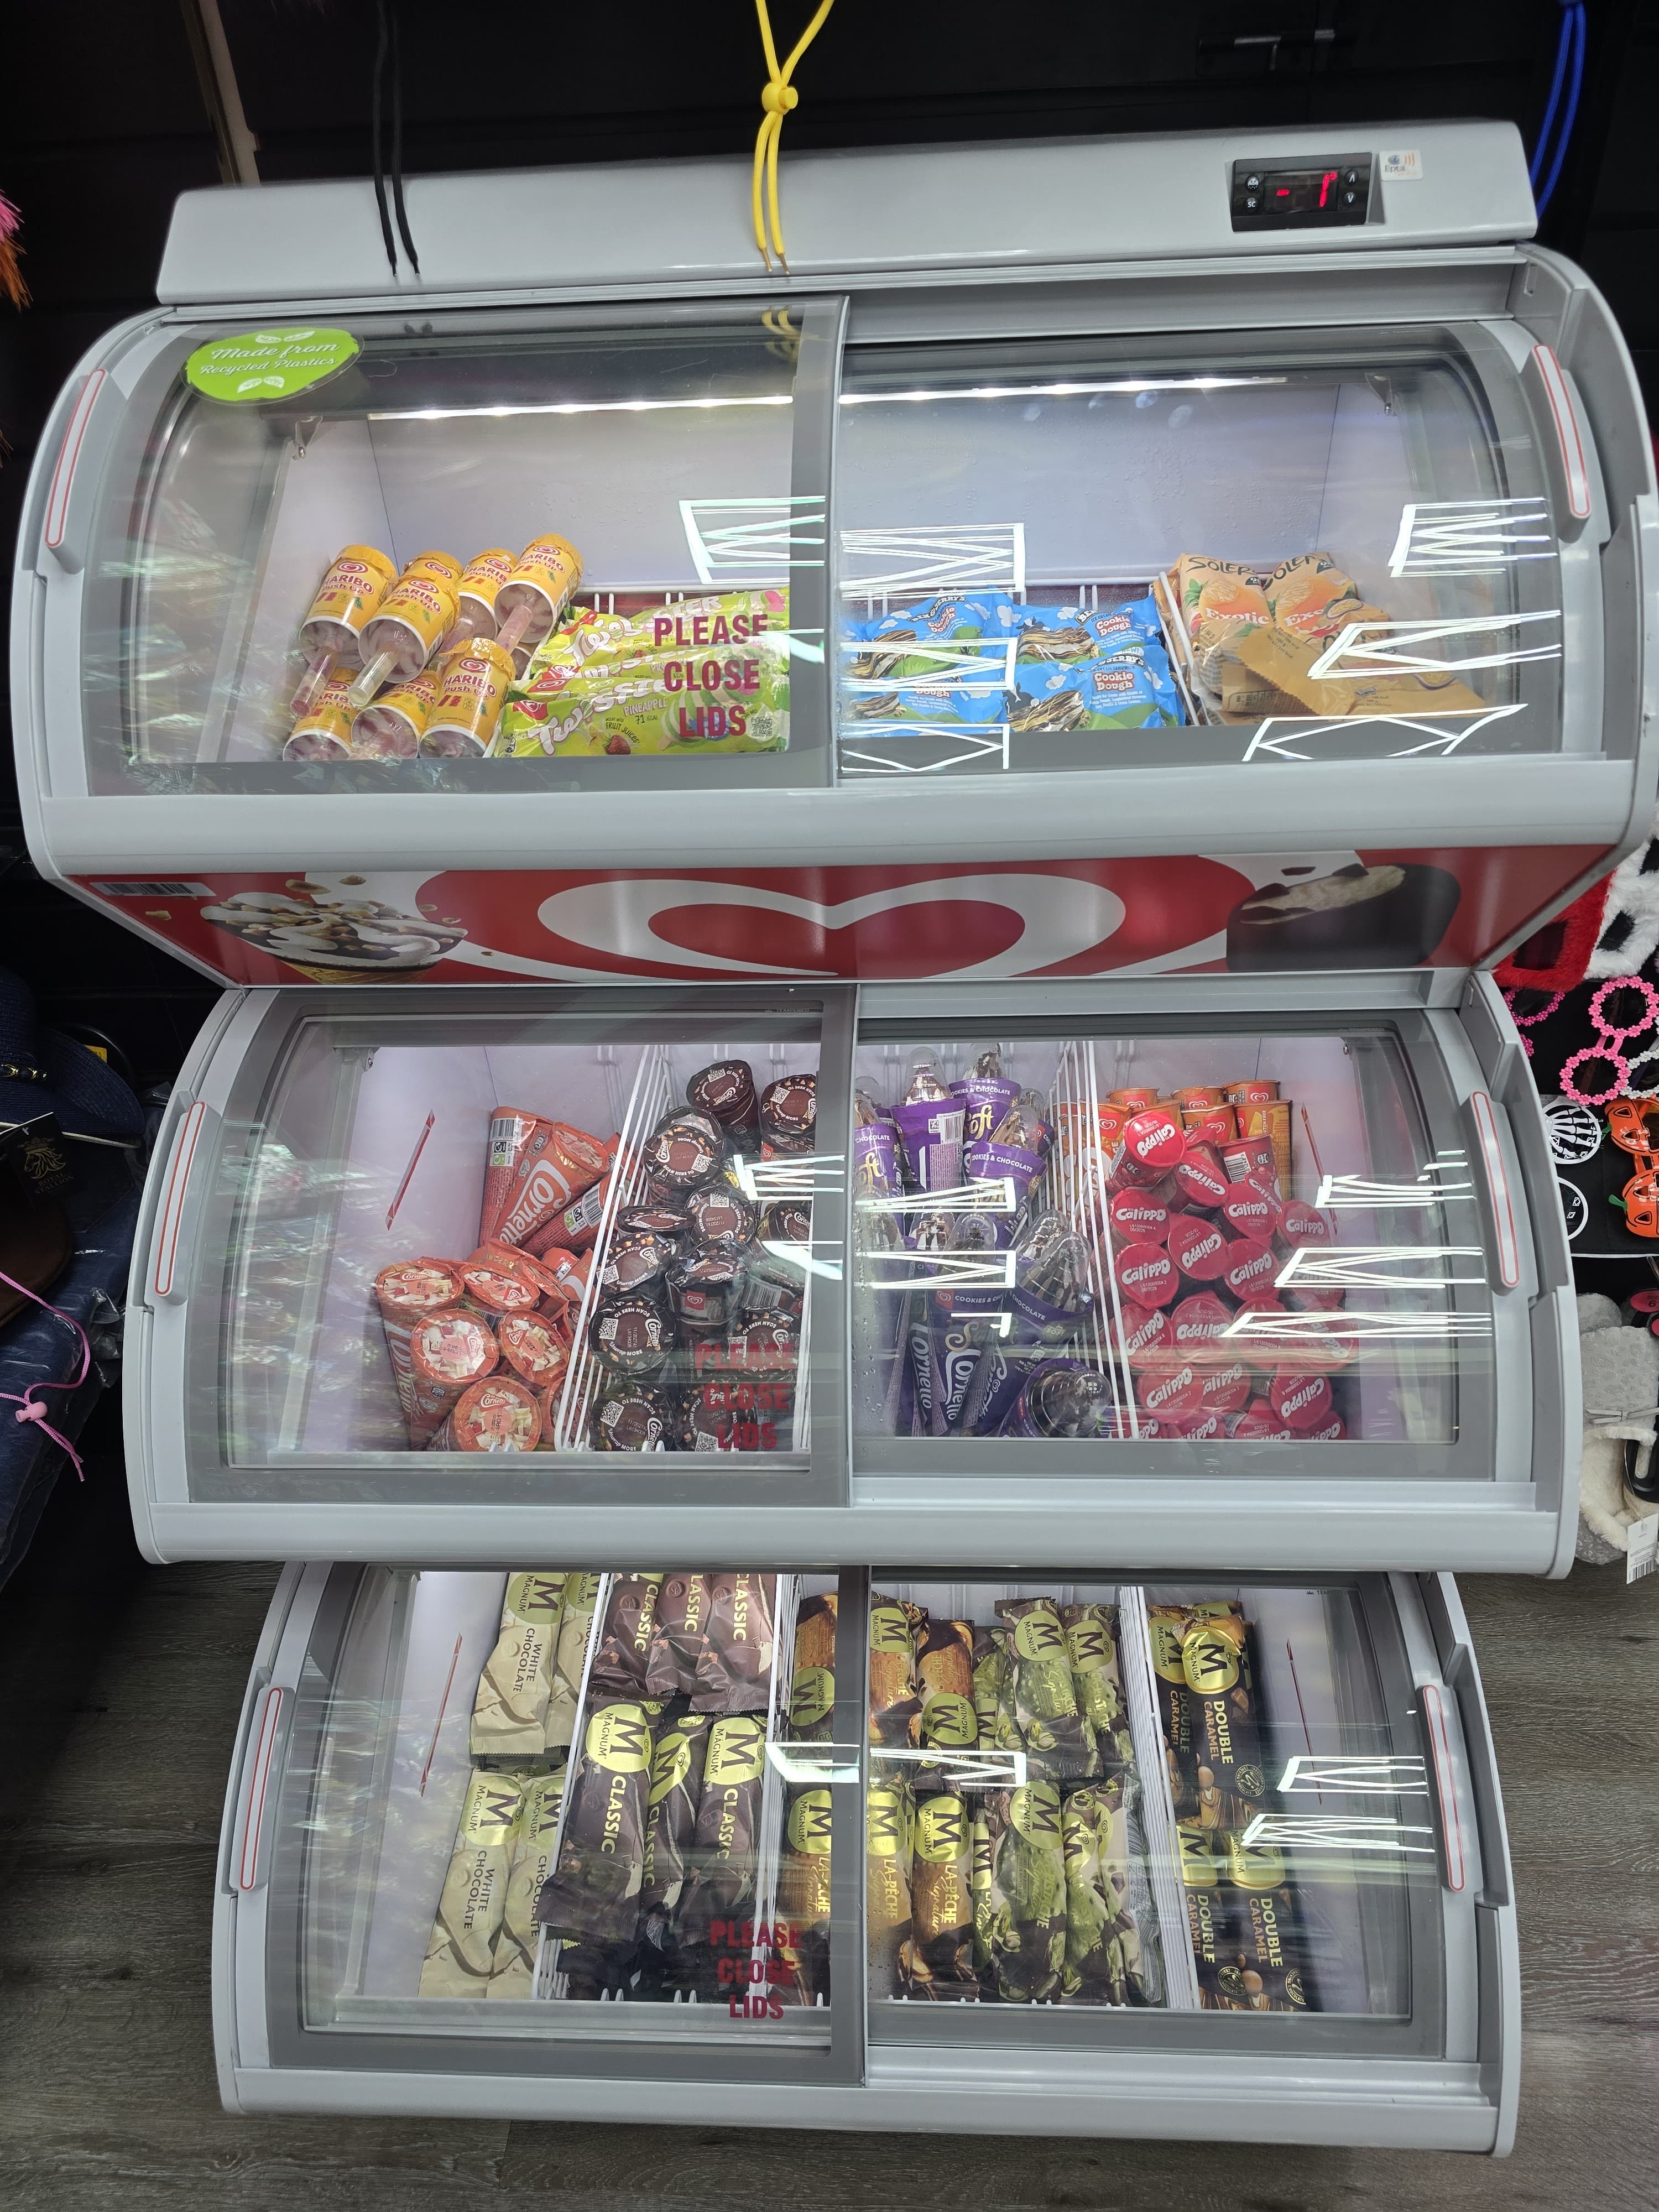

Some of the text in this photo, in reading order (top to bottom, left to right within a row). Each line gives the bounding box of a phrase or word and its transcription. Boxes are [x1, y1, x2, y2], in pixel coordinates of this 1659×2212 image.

[1385, 165, 1405, 173] Epta
[200, 357, 337, 375] Recycled Plastics
[212, 343, 340, 359] Made from
[470, 566, 508, 582] HARIB
[1186, 557, 1257, 576] SOLER
[325, 575, 374, 594] HARIBO
[393, 588, 442, 614] HARIBO
[655, 614, 768, 646] PLEASE
[1099, 623, 1131, 637] Dough
[1204, 607, 1271, 625] Exotic
[1283, 608, 1324, 627] Exo
[444, 674, 497, 696] HARIBO
[664, 659, 760, 692] CLOSE
[1094, 671, 1134, 681] Cookie
[1097, 681, 1134, 691] Dough
[624, 698, 667, 717] PINEAPPLE
[636, 715, 645, 724] 71
[679, 705, 747, 738] LIDS
[606, 722, 620, 731] FRUIT
[975, 1086, 1010, 1095] CHOCOLATE
[969, 1104, 995, 1140] oft
[1137, 1124, 1176, 1157] Calippo
[996, 1156, 1034, 1173] CHOCOLATE
[1178, 1164, 1225, 1196] Calippo
[1228, 1201, 1269, 1217] Calippo
[1249, 1178, 1282, 1213] Calippo
[1116, 1207, 1167, 1222] Calippo
[1286, 1218, 1325, 1235] Calippo
[1182, 1233, 1222, 1268] Calippo
[1121, 1259, 1171, 1285] Calippo
[1230, 1253, 1272, 1285] Calippo
[635, 1307, 650, 1318] SCAN
[1012, 1293, 1047, 1321] CHOCOLATE
[609, 1340, 627, 1357] Unwrap
[645, 1318, 662, 1347] Cornetto
[1125, 1311, 1165, 1357] Calippo
[695, 1343, 797, 1371] PLEASE
[1146, 1368, 1193, 1408] Calippo
[1203, 1363, 1243, 1396] alippo
[480, 1393, 506, 1407] Cornetto
[643, 1401, 656, 1415] SCAN
[703, 1383, 790, 1410] CLOSE
[1281, 1378, 1324, 1418] Calippo
[608, 1428, 621, 1447] Unwrap
[717, 1422, 778, 1449] LIDS
[518, 1575, 535, 1613] MAGNUM
[528, 1579, 566, 1612] M
[684, 1574, 704, 1632] LASSIC
[634, 1584, 659, 1651] CLASSIC
[872, 1614, 881, 1647] MAGNUM
[880, 1617, 907, 1644] M
[1023, 1621, 1038, 1657] MAGNUM
[1032, 1622, 1063, 1651] M
[1068, 1631, 1079, 1668] MAGNUM
[1077, 1631, 1104, 1663] M
[1156, 1626, 1168, 1668] MAGNUM
[513, 1627, 535, 1693] CHOCOLATE
[526, 1643, 542, 1682] WHITE
[1189, 1641, 1200, 1682] MAGNUM
[1198, 1644, 1228, 1677] M
[598, 1712, 614, 1757] MAGNUM
[933, 1704, 962, 1733] M
[959, 1700, 969, 1739] MAGNUM
[1170, 1690, 1181, 1746] CARAMEL
[1179, 1691, 1191, 1754] DOUBLE
[1204, 1701, 1219, 1761] CARAMEL
[1213, 1700, 1234, 1764] DOUBLE
[609, 1716, 647, 1757] M
[709, 1728, 725, 1775] MAGNUM
[721, 1731, 761, 1770] M
[468, 1785, 487, 1833] MAGNUM
[479, 1790, 522, 1829] M
[528, 1791, 544, 1840] MAGNUM
[601, 1775, 627, 1855] CLASSIC
[716, 1788, 739, 1860] CLASSIC
[797, 1800, 808, 1845] MAGNUM
[870, 1804, 899, 1838] M
[1022, 1788, 1032, 1833] MAGNUM
[1032, 1793, 1061, 1834] M
[924, 1808, 933, 1854] MAGNUM
[933, 1811, 963, 1849] M
[643, 1806, 660, 1888] CLASSIC
[1230, 1829, 1246, 1875] MAGNUM
[463, 1850, 487, 1930] CHOCOLATE
[477, 1867, 495, 1912] WHITE
[709, 1920, 803, 1949] PLEASE
[1186, 1893, 1202, 1955] CARAMEL
[1197, 1895, 1215, 1964] DOUBLE
[1249, 1897, 1269, 1964] CARAMEL
[1260, 1897, 1284, 1967] DOUBLE
[717, 1958, 796, 1985] CLOSE
[729, 1995, 784, 2020] LIDS
